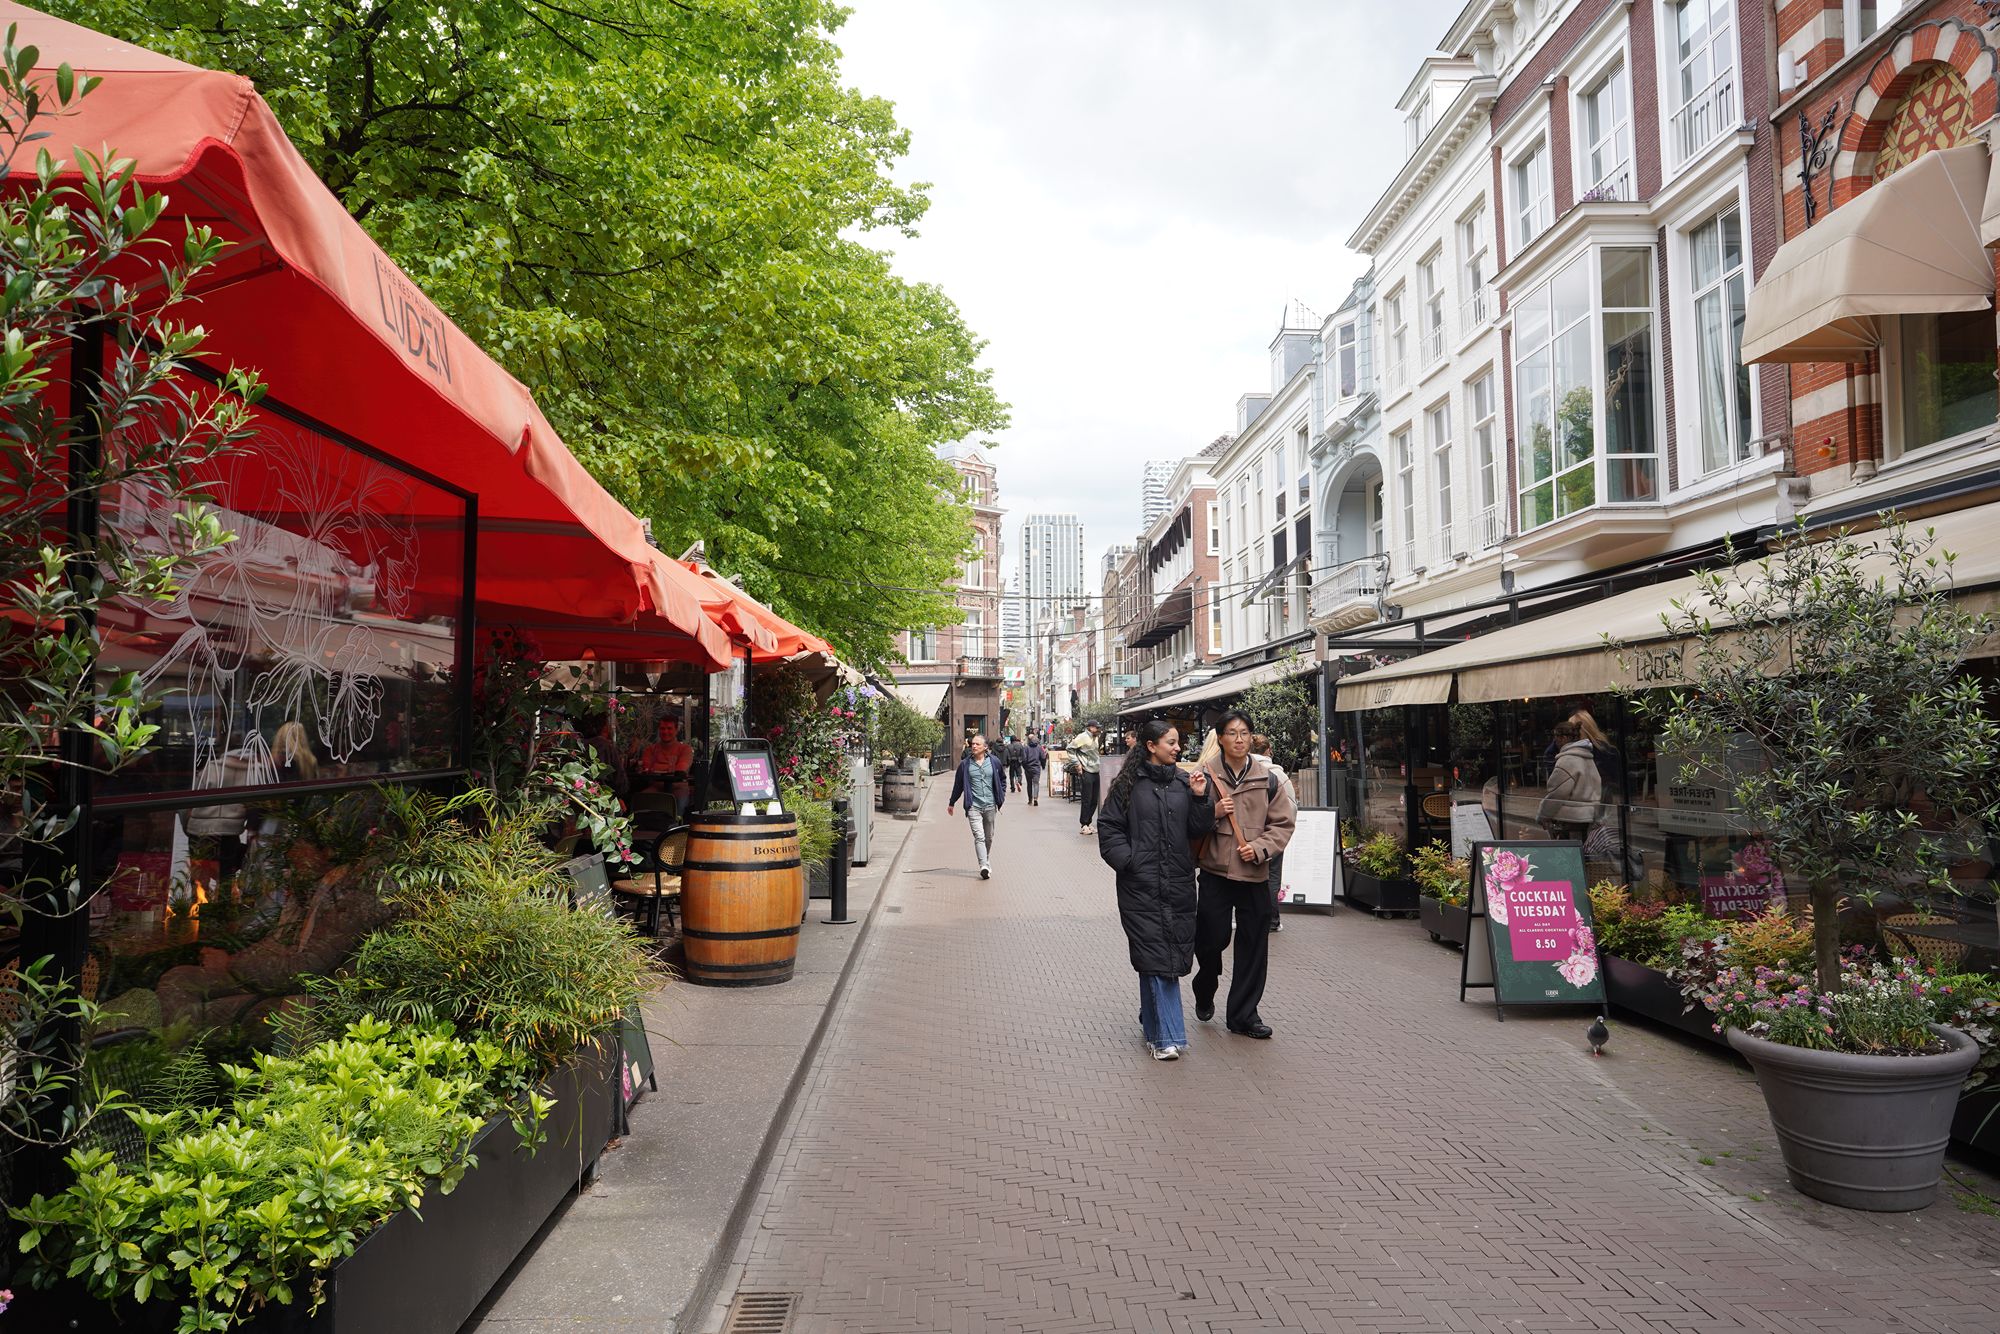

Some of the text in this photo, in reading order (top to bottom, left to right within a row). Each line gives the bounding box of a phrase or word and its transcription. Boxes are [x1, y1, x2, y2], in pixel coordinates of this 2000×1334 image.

[373, 253, 451, 384] LUDEN
[753, 845, 798, 855] BOSCHEN
[1510, 891, 1567, 902] COCKTAIL
[1513, 905, 1566, 917] TUESDAY
[1535, 938, 1557, 949] 8.50
